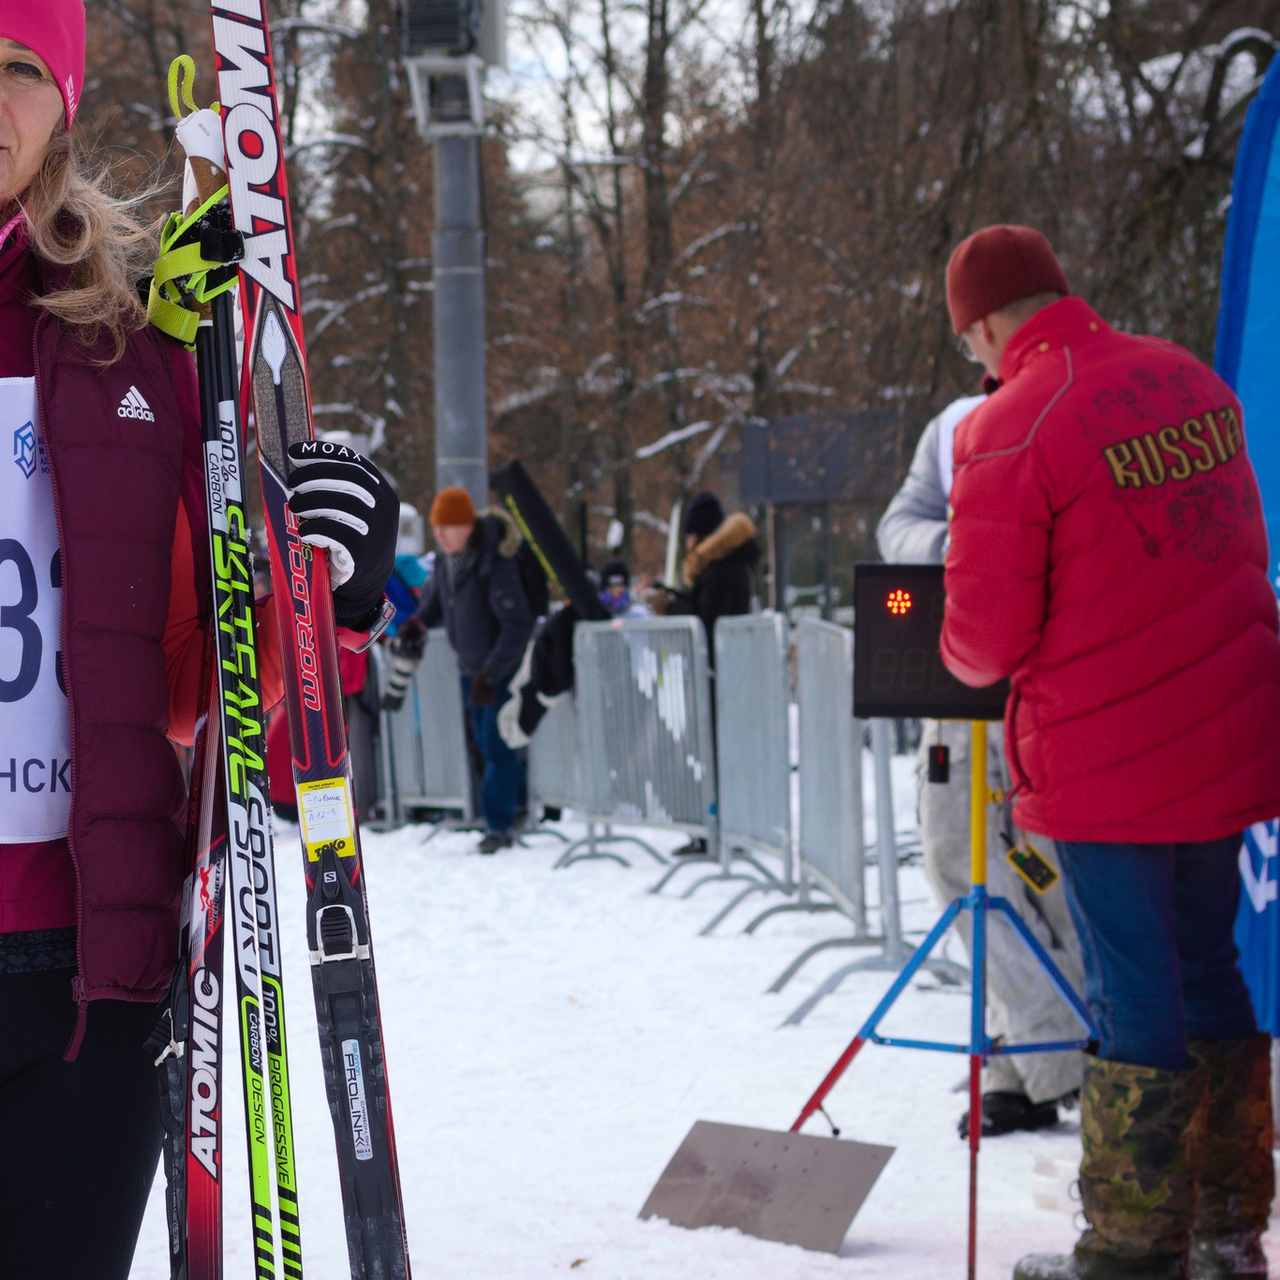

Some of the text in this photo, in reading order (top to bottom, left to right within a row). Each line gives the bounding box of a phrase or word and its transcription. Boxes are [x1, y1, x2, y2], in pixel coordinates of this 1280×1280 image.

[117, 405, 156, 423] adidas
[302, 442, 361, 462] MOAX
[1102, 405, 1244, 489] RUSSIA
[209, 453, 223, 514] CARBON
[249, 1012, 261, 1068] CARBON
[190, 968, 220, 1180] ATOMIC
[251, 1077, 266, 1145] DESIGN
[269, 1057, 290, 1185] PROGRESSIVE
